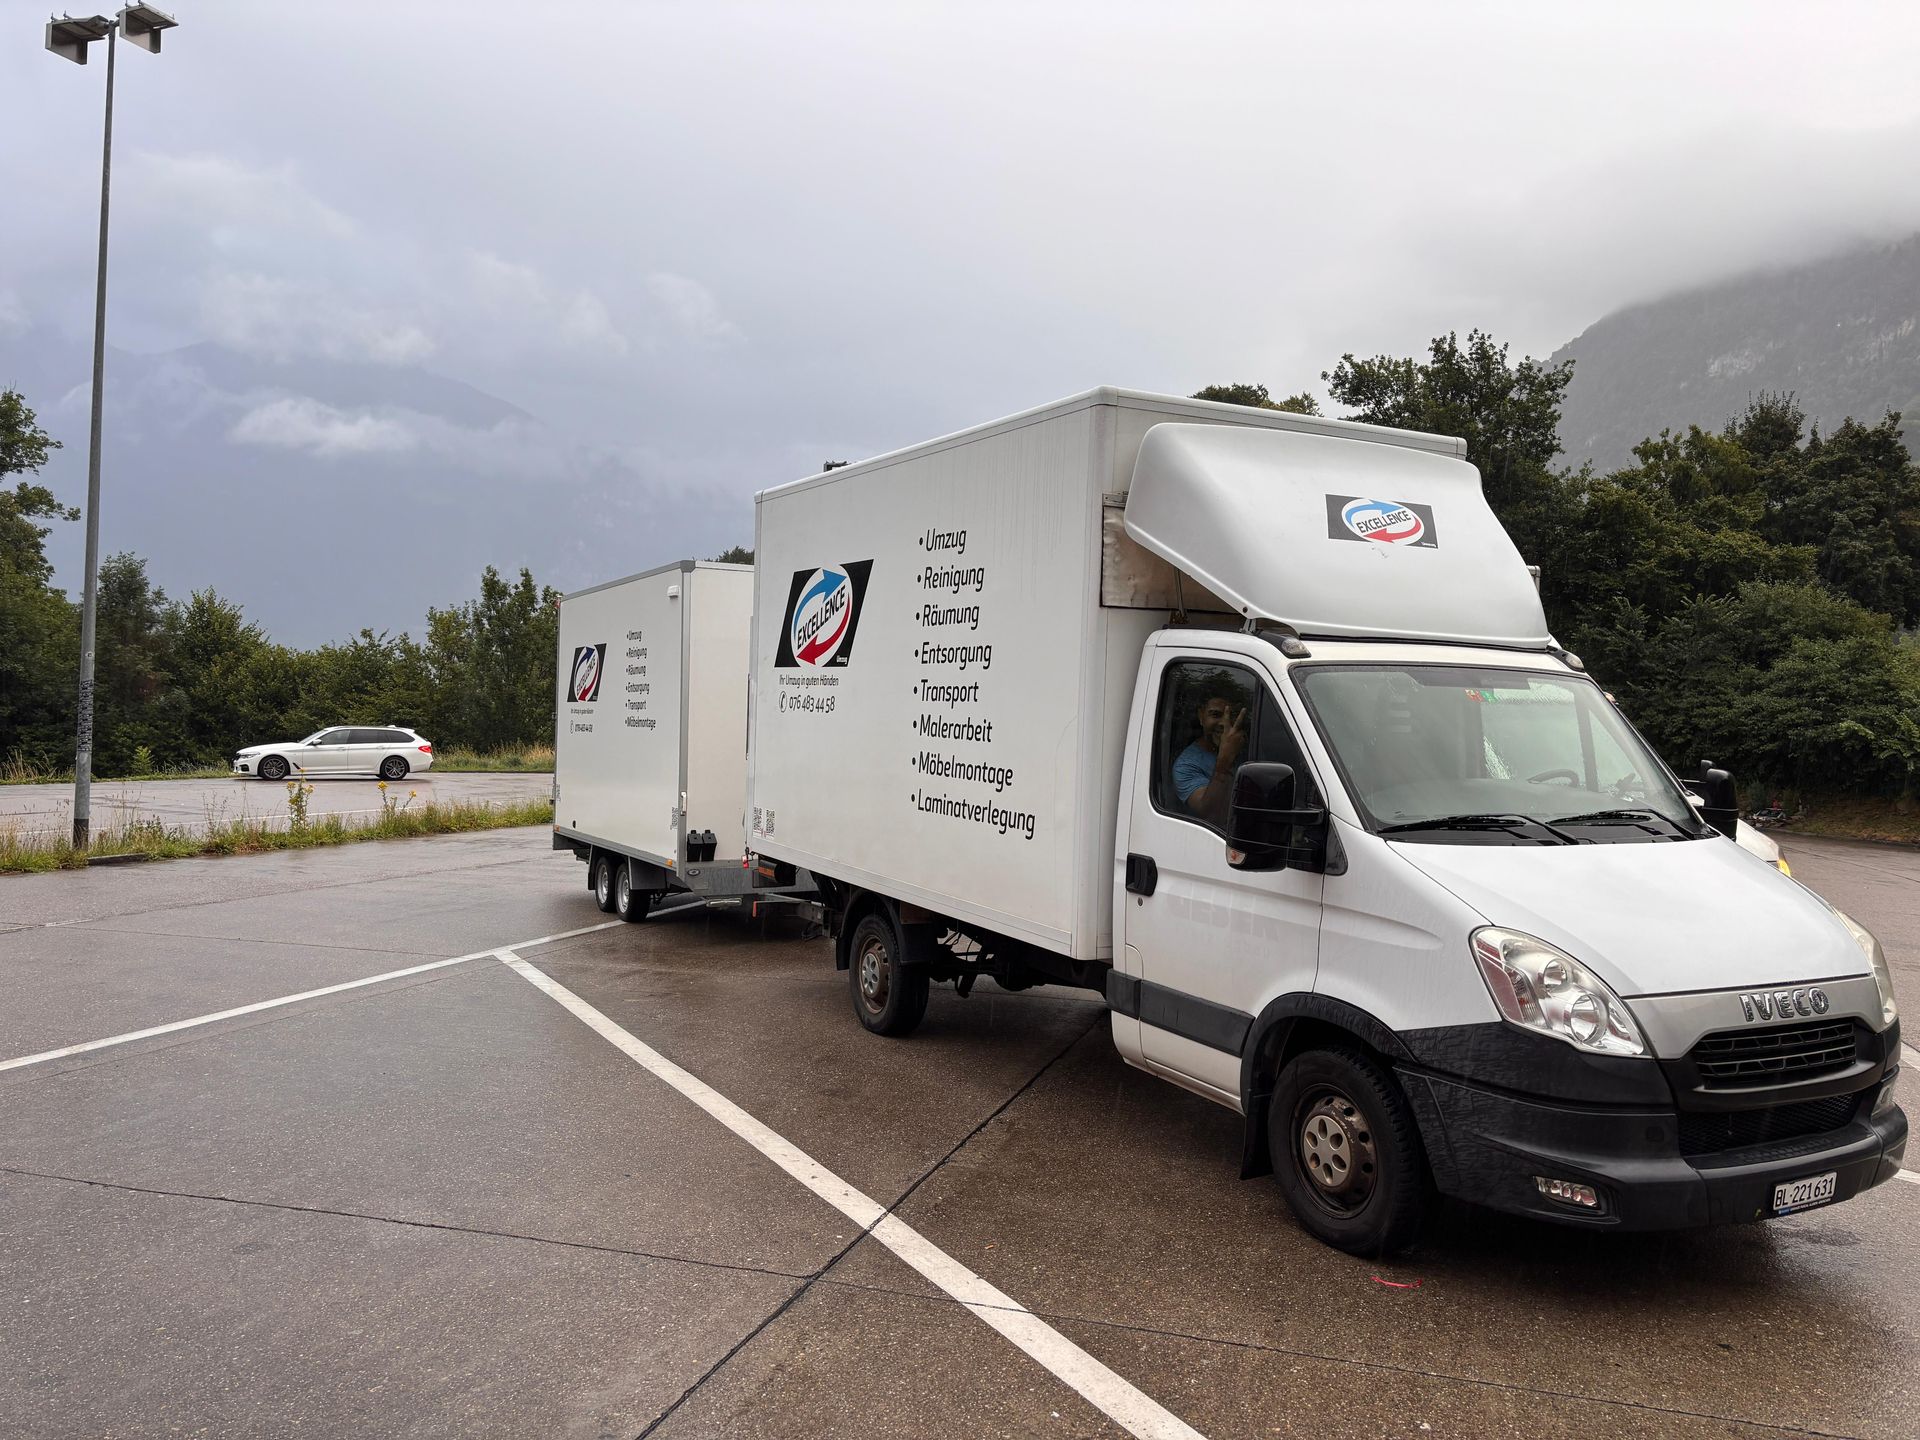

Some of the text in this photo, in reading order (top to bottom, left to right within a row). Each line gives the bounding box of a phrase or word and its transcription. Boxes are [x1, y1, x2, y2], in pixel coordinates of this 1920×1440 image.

[1356, 511, 1412, 533] EXCELLENCE
[925, 528, 967, 554] Umzug
[923, 564, 985, 594] Reinigung
[797, 584, 846, 650] EXCELLENCE
[922, 604, 980, 630] Räumung
[921, 641, 992, 670] Entsorgung
[786, 674, 801, 689] Umzug
[806, 675, 820, 689] guten
[920, 679, 979, 709] Transport
[789, 694, 836, 714] 076 483 44 58
[919, 713, 993, 742] Malerarbeit
[918, 751, 1013, 792] Möbelmontage
[917, 788, 1036, 840] Laminatverlegung
[1739, 987, 1830, 1023] IVECO
